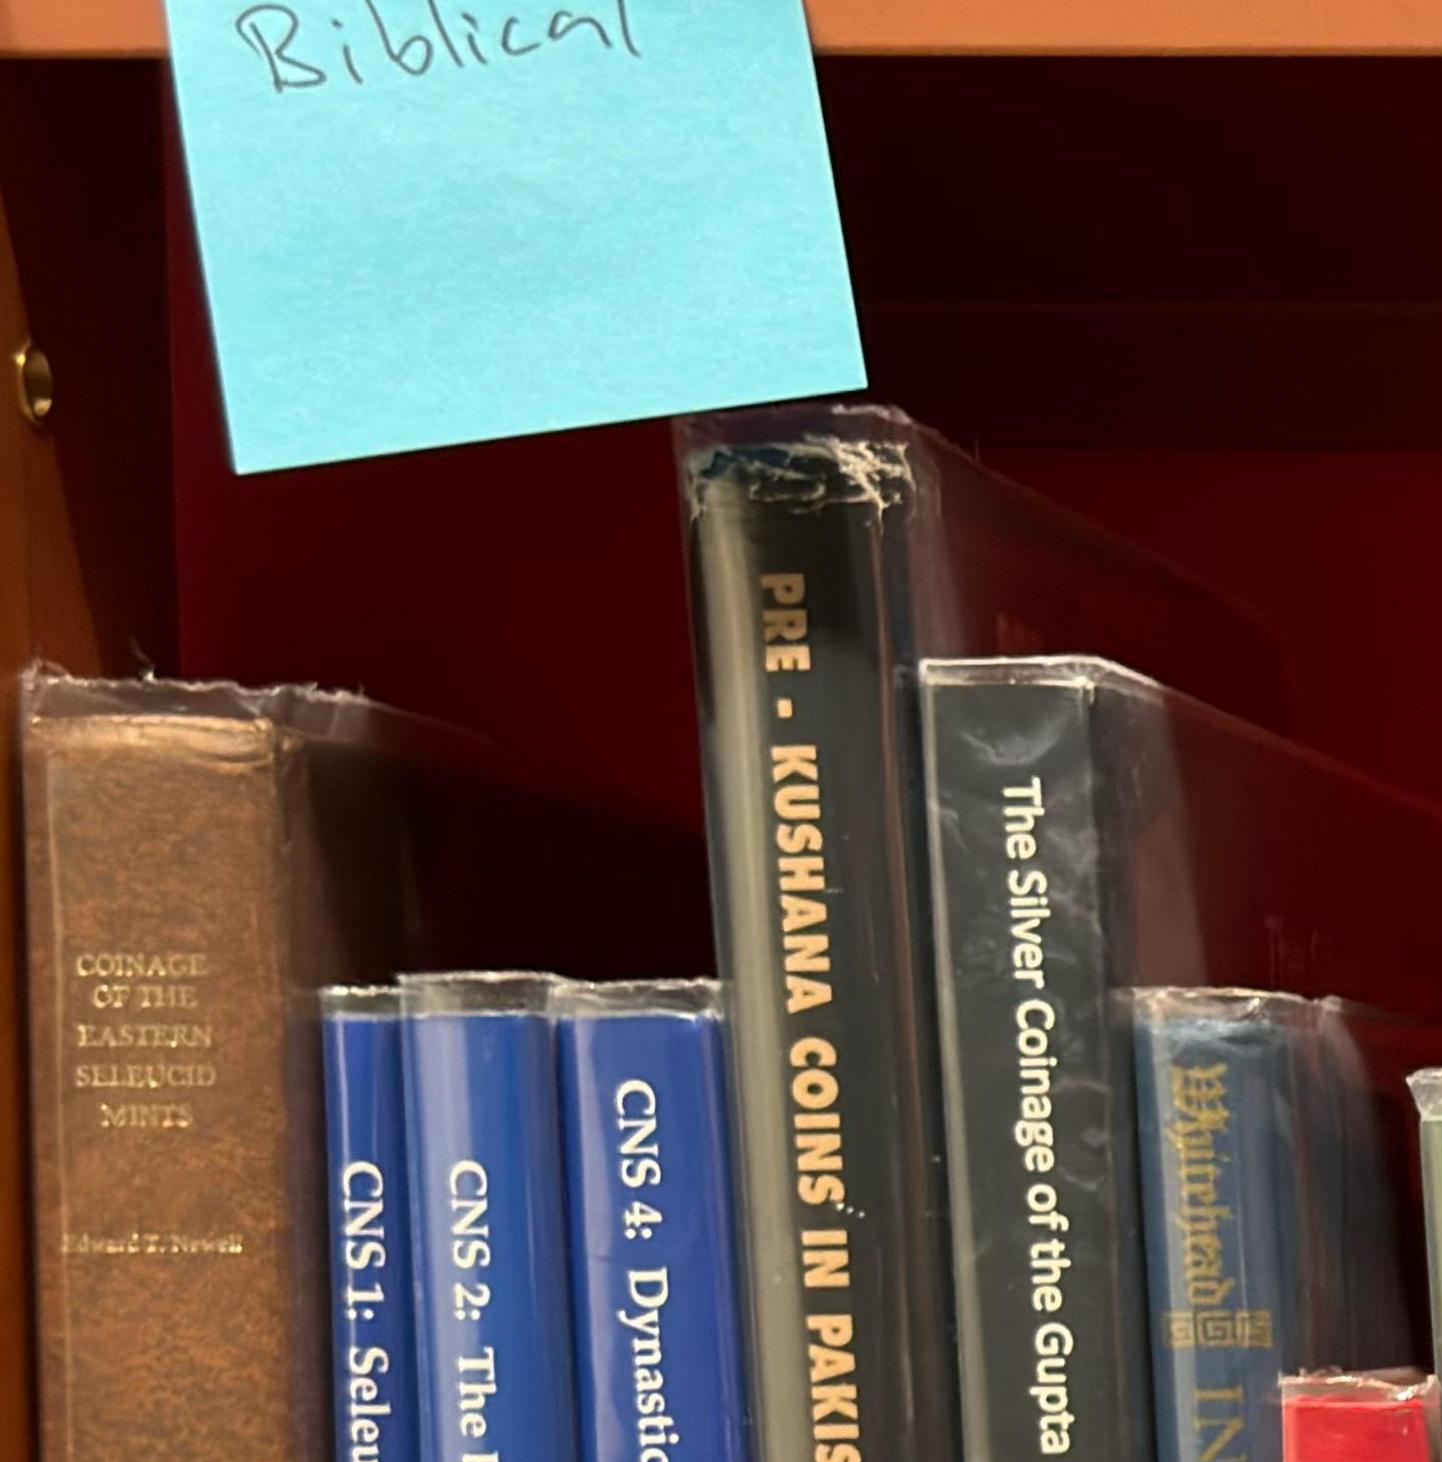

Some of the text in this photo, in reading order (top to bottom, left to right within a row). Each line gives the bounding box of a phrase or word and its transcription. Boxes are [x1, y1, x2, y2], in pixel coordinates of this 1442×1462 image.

[236, 0, 642, 93] Biblical
[761, 573, 811, 672] PRE
[1003, 776, 1044, 860] The
[770, 744, 833, 1014] KUSHANA
[76, 953, 207, 977] COINAGE
[1007, 870, 1050, 989] Silver
[77, 1024, 212, 1048] EASTERN
[92, 984, 198, 1008] OF THE
[76, 1064, 216, 1088] SELEUCID
[100, 1104, 193, 1128] MINTS
[1014, 999, 1057, 1174] Coinage
[615, 1078, 662, 1188] CNS
[789, 1037, 845, 1206] COINS
[341, 1160, 386, 1270] CNS
[449, 1159, 491, 1270] CNS
[623, 1201, 662, 1240] 4:
[1025, 1184, 1069, 1232] of
[801, 1230, 850, 1289] IN
[1029, 1241, 1071, 1313] the
[346, 1284, 385, 1321] 1:
[454, 1284, 490, 1321] 2:
[457, 1347, 497, 1438] The
[1030, 1322, 1075, 1455] Gupta
